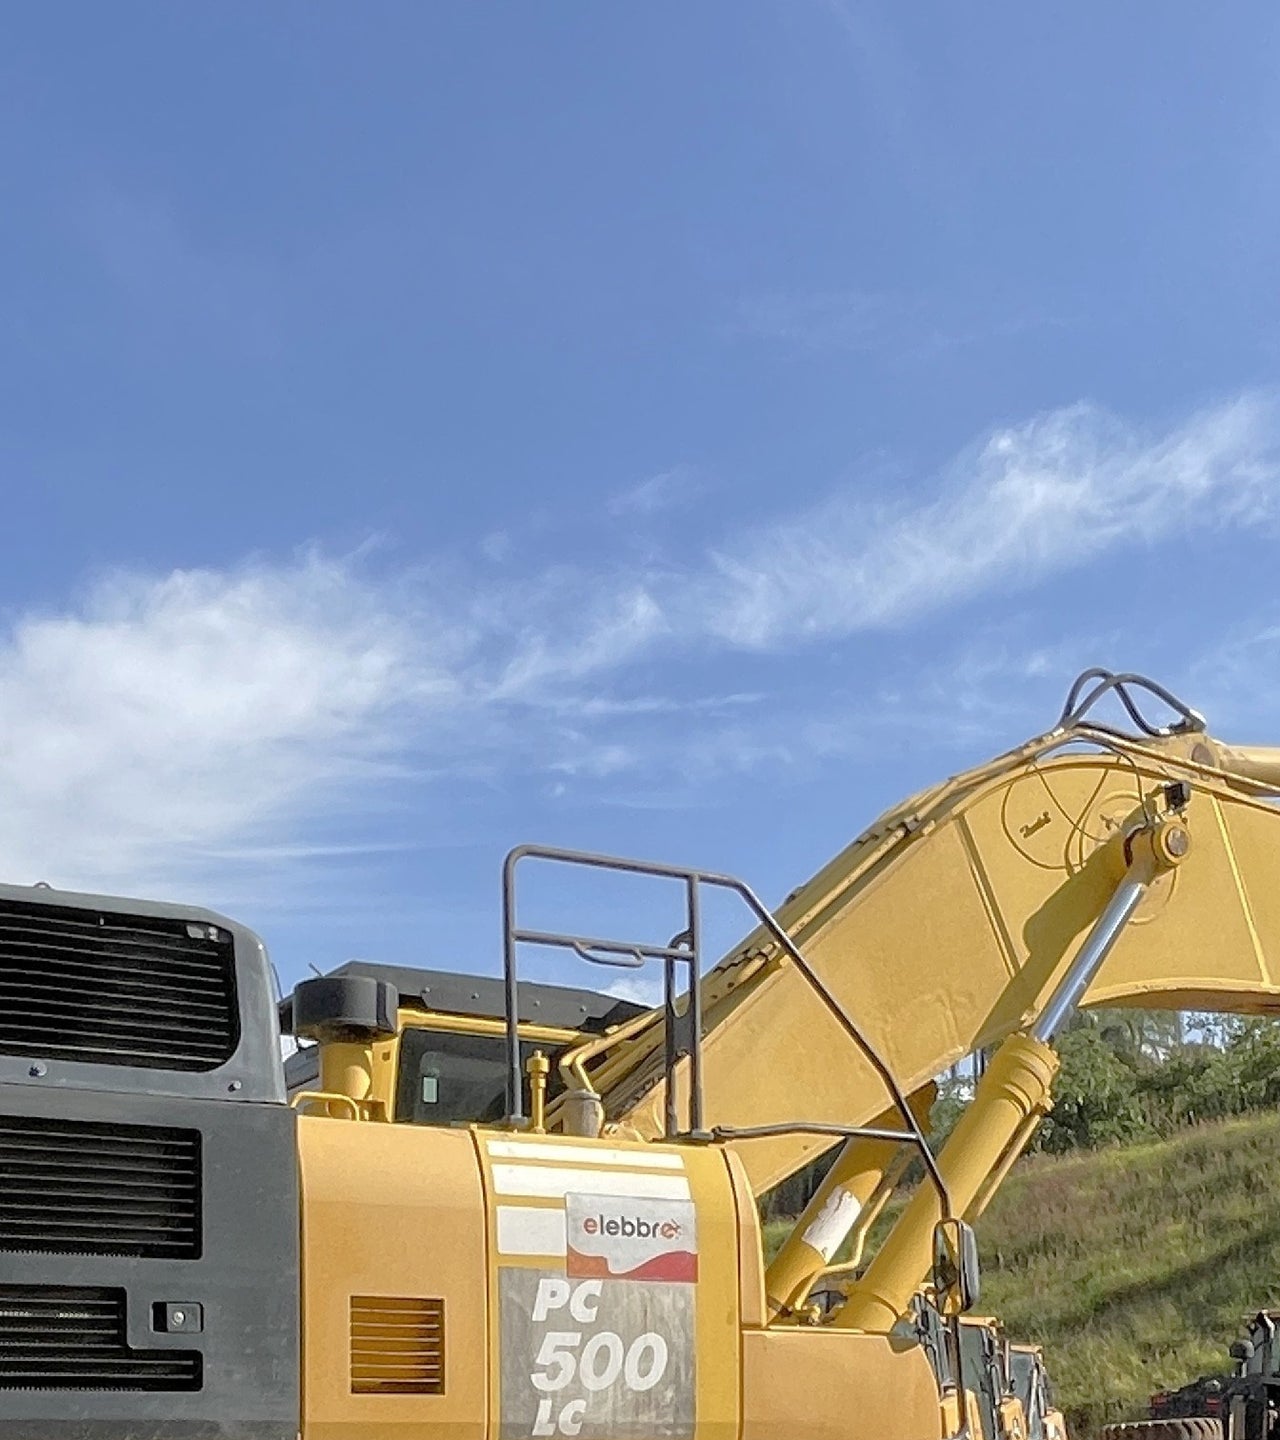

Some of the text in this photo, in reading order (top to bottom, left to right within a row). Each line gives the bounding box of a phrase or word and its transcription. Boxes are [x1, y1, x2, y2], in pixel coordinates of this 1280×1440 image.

[583, 1213, 678, 1240] elebbre
[531, 1278, 603, 1324] PC
[530, 1331, 669, 1393] 500
[531, 1399, 587, 1437] LC
